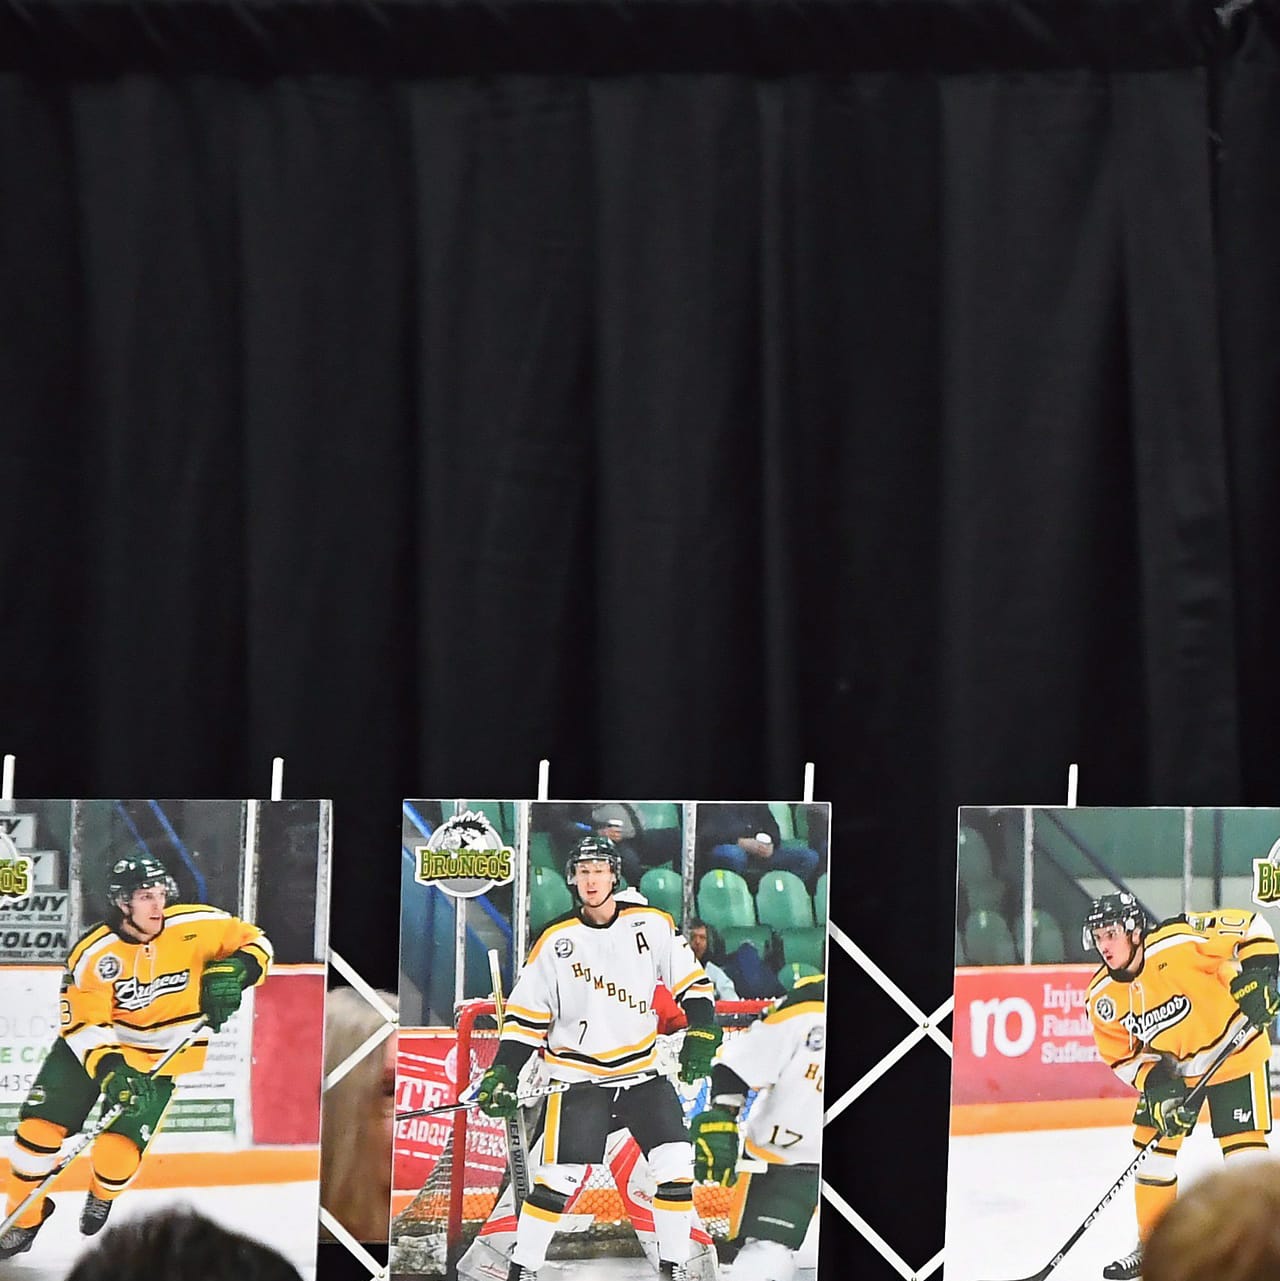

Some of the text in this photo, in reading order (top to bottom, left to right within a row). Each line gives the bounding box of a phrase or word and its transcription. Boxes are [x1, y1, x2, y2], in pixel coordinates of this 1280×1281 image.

[419, 848, 511, 882] BRONCOS
[635, 931, 650, 954] A
[571, 962, 657, 1015] HUMBOLD
[1043, 983, 1087, 1014] Inju
[578, 1020, 589, 1045] 7
[970, 996, 1036, 1058] ro
[769, 1124, 803, 1149] 17
